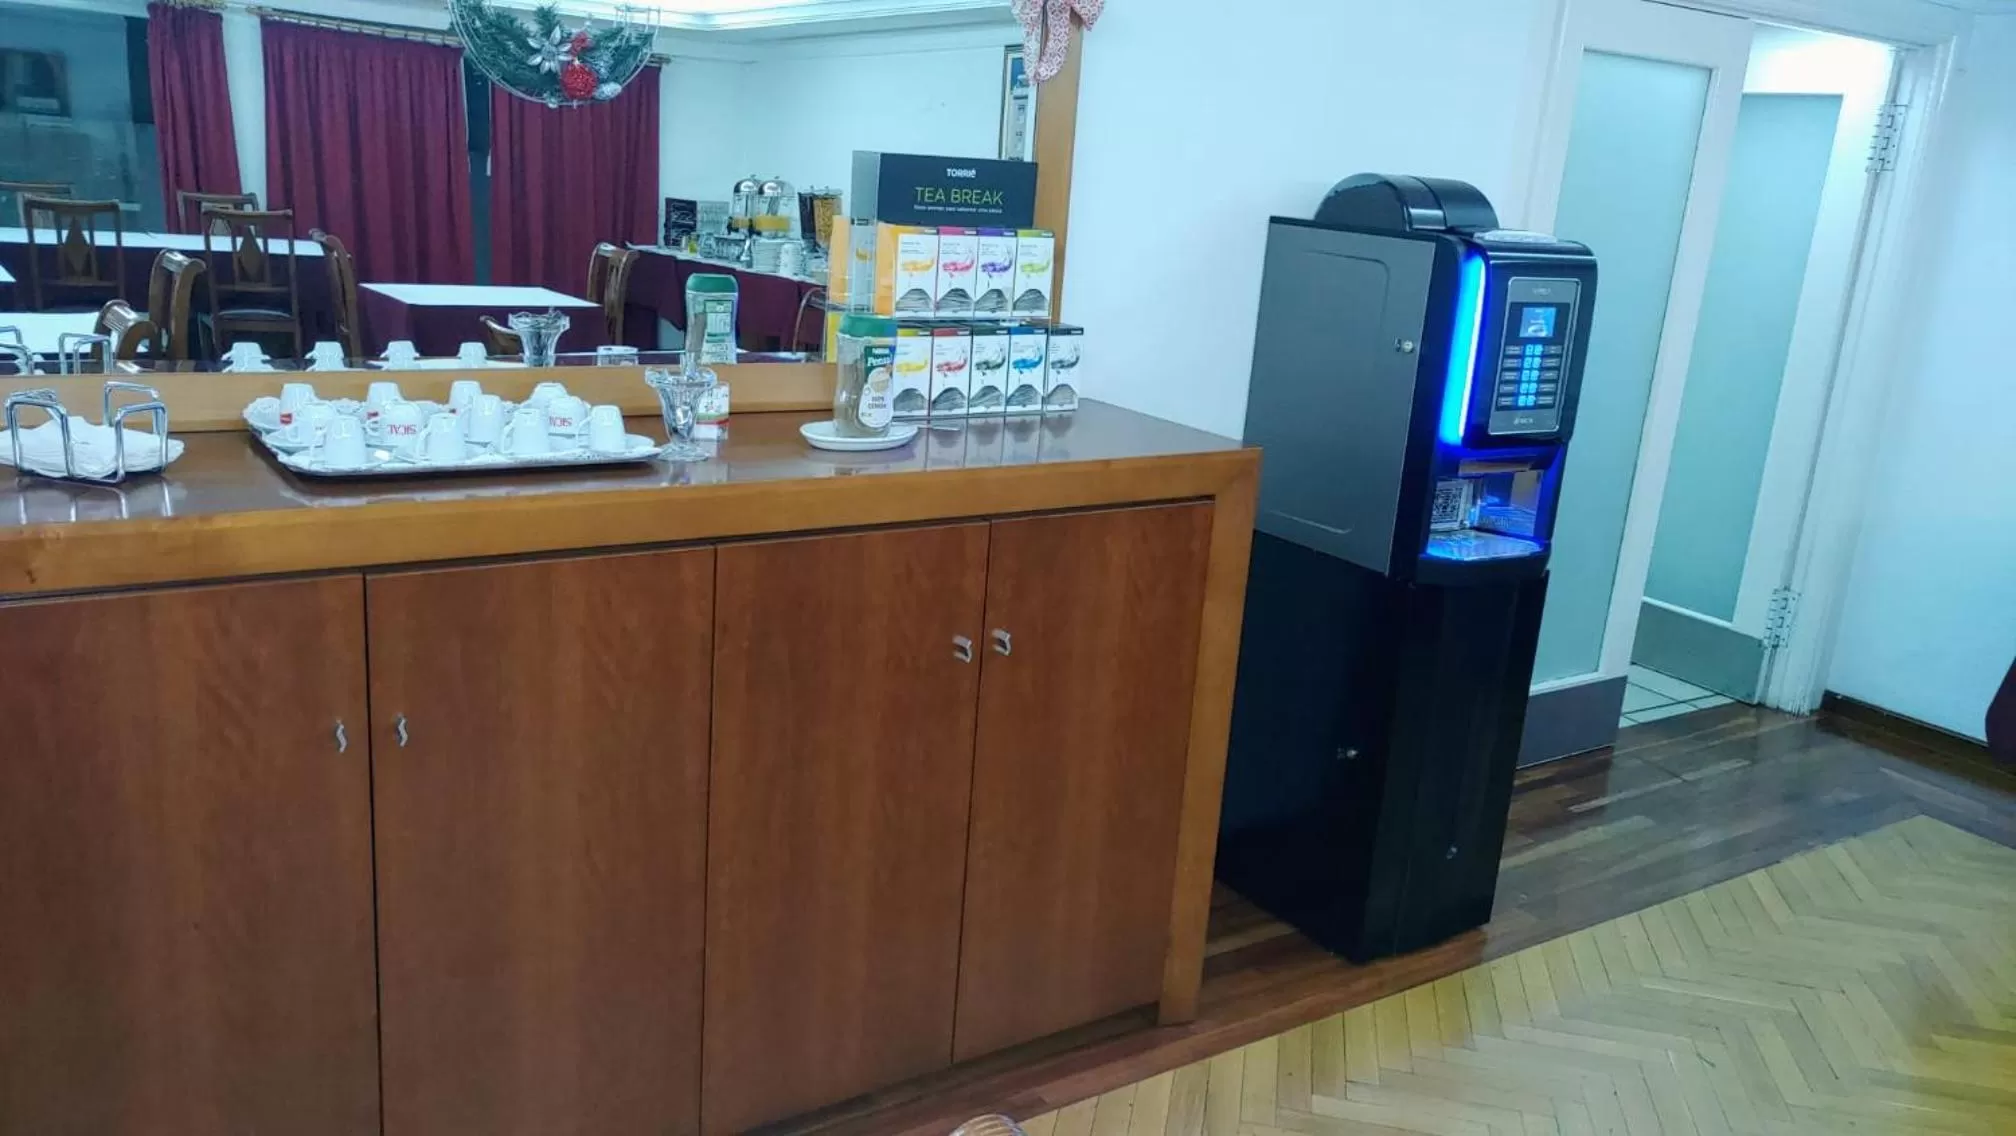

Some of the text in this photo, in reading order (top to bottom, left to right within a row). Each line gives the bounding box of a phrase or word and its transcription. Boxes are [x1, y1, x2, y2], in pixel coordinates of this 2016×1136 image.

[915, 186, 1004, 205] TEA BREAK
[387, 424, 418, 436] SICAL
